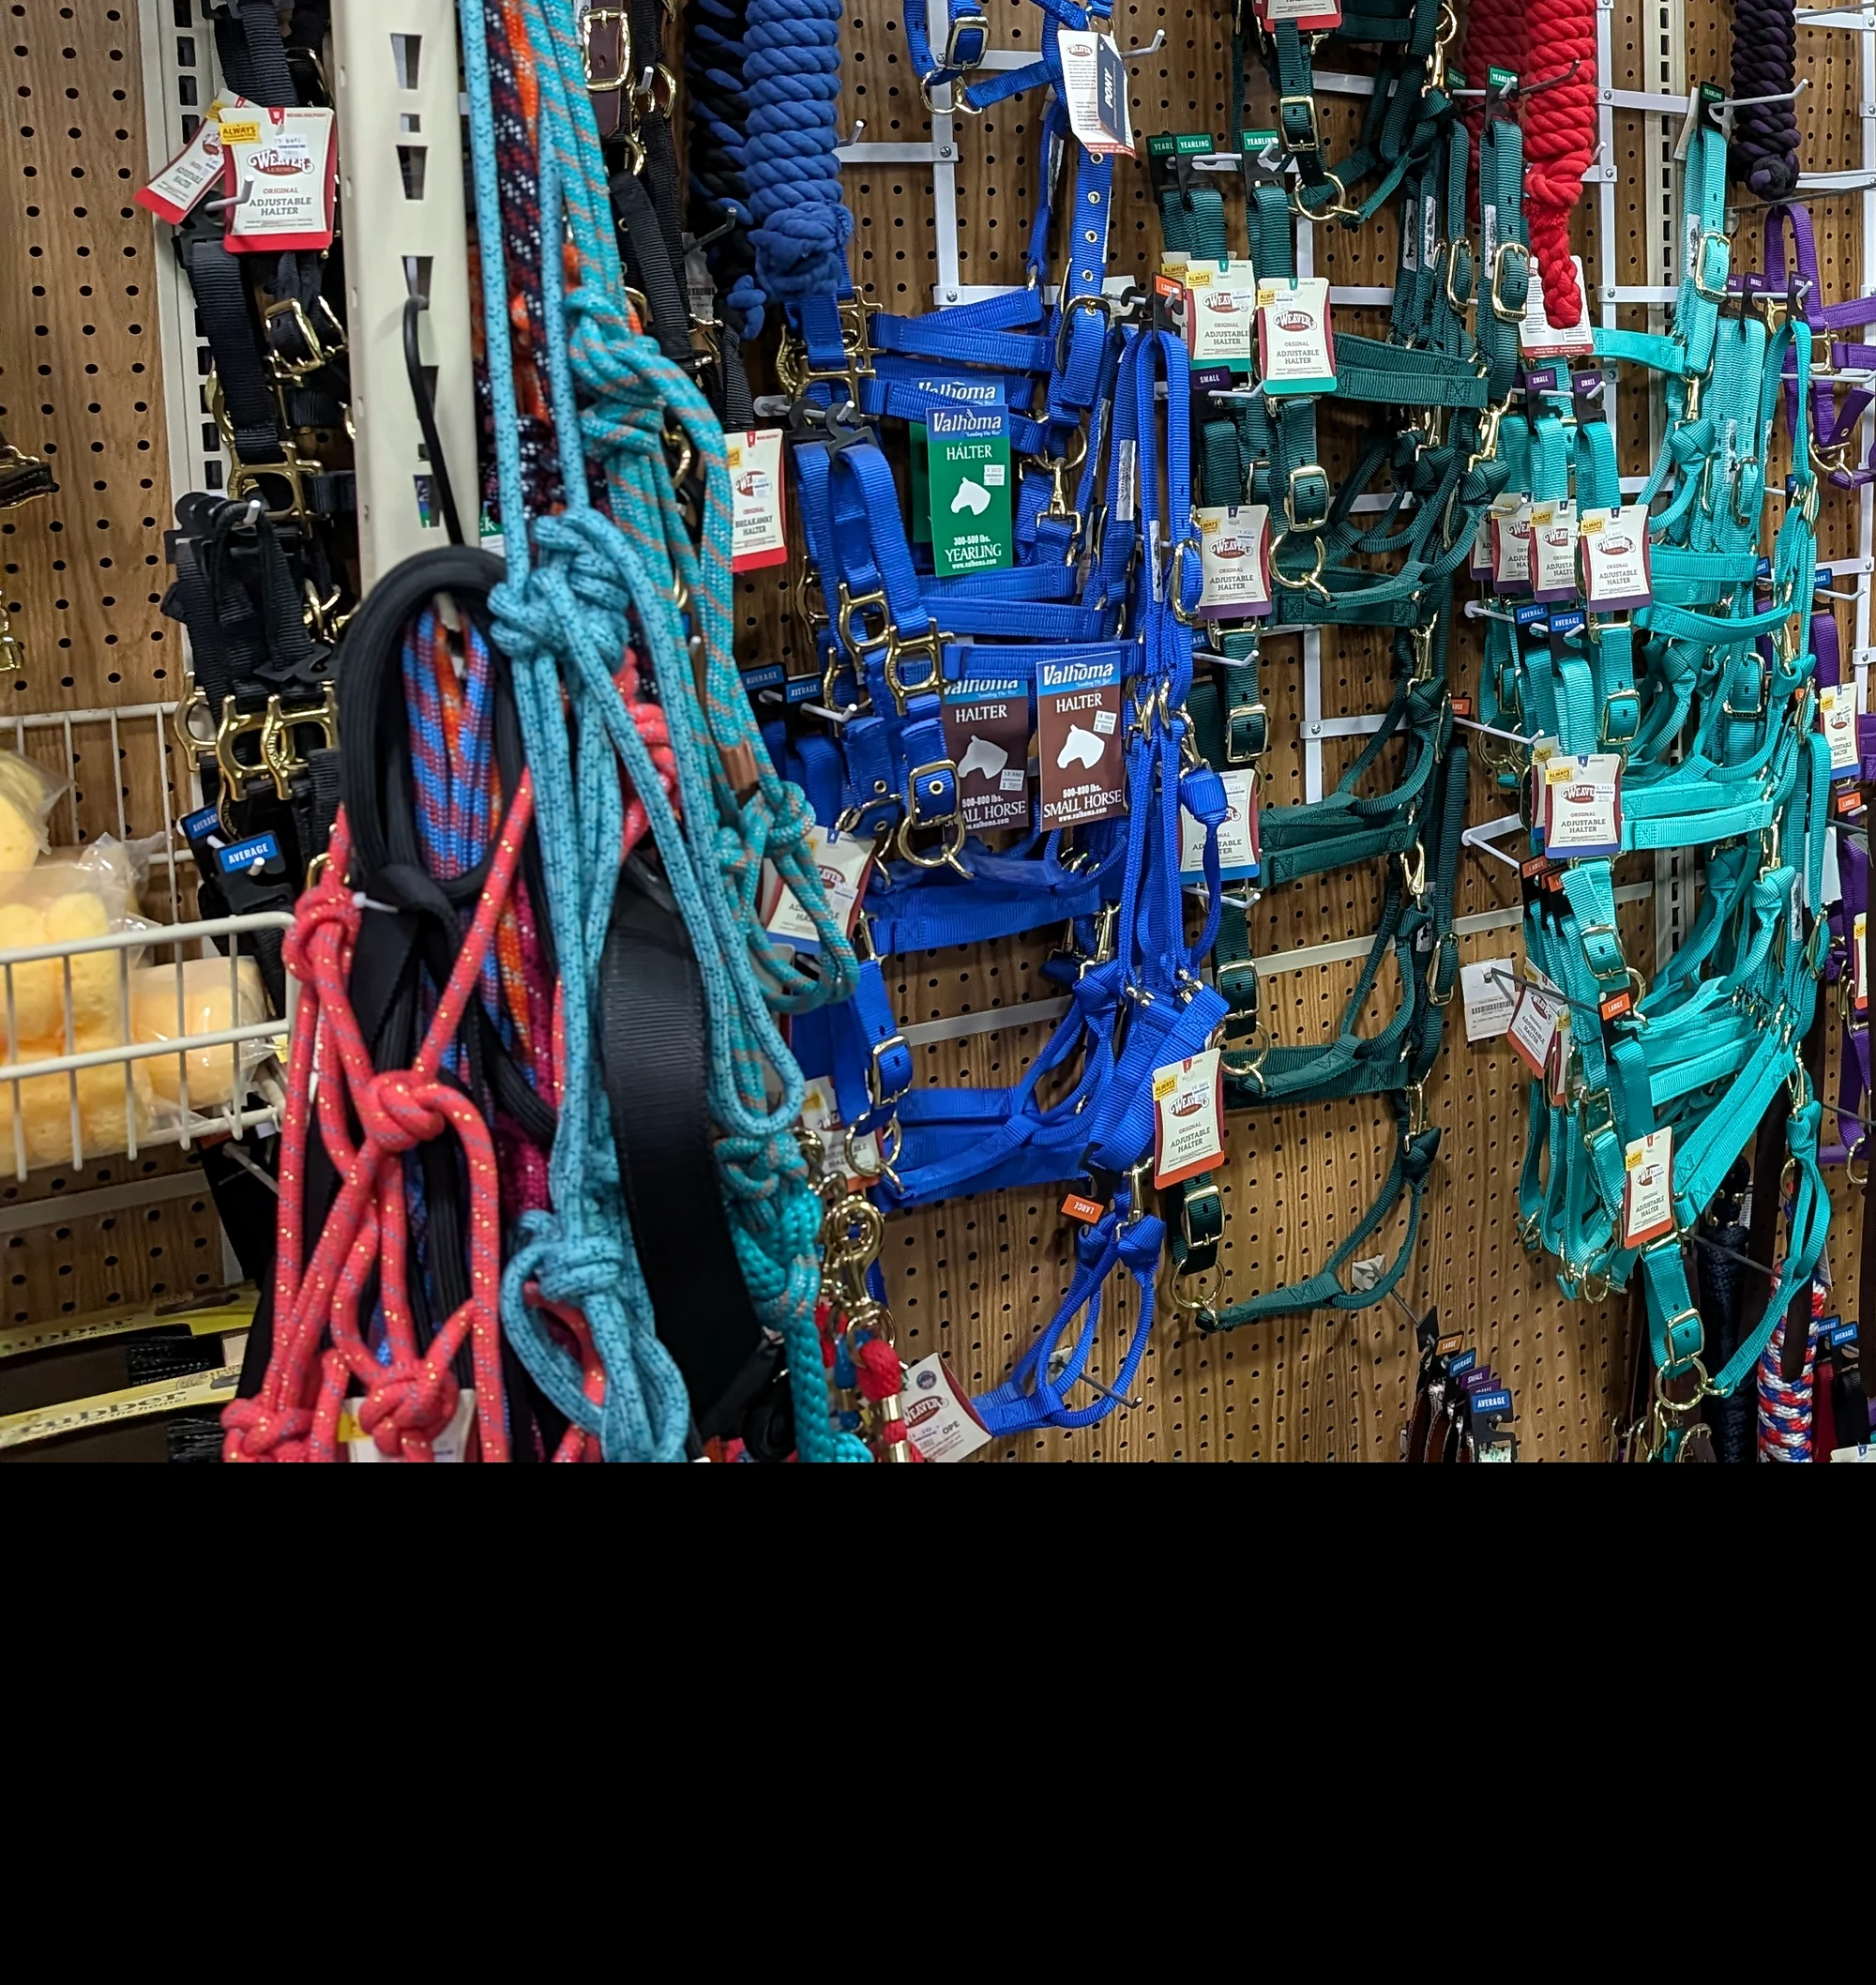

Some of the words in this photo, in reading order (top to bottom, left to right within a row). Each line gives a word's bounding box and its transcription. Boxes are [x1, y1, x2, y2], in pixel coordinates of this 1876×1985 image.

[1104, 68, 1113, 109] PONY
[222, 126, 256, 136] ALWAYS
[1154, 143, 1174, 151] YEARL
[1180, 139, 1210, 149] YEARLING
[1247, 137, 1273, 147] YEARLI
[250, 197, 311, 207] ADJUSTABLE
[261, 207, 298, 216] HALTER
[1188, 274, 1211, 283] ALWAYS
[1273, 310, 1318, 330] WEAVER
[1204, 330, 1249, 339] ADJUSTABLE
[1213, 338, 1242, 346] HALTER
[1199, 374, 1220, 385] SMALL
[1533, 375, 1549, 385] SMALL
[933, 413, 1002, 432] Valhoma
[735, 515, 773, 528] BREAKAWAY
[1532, 513, 1551, 523] ALWAYS
[743, 525, 766, 536] HALTER
[1582, 521, 1603, 530] ALWAYS
[954, 535, 978, 546] 300-500
[945, 543, 1002, 563] YEARLING
[1546, 563, 1575, 571] ADJUSTA
[1210, 575, 1253, 584] ADJUSTABLE
[1599, 569, 1638, 579] ADJUSTABLE
[1521, 608, 1544, 619] AVERAGE
[1555, 617, 1580, 628] AVERAGE
[746, 671, 778, 685] AVERAGE
[1043, 662, 1114, 687] Valhoma
[791, 684, 818, 697] AVERAGE
[1056, 692, 1102, 713] HALTER
[956, 705, 1007, 722] HALTER
[1549, 770, 1570, 779] ALWAYS
[1063, 785, 1090, 798] 500-800
[1561, 784, 1595, 799] WEAVE
[962, 796, 990, 808] 500-800
[1043, 798, 1080, 818] SMALL
[1083, 789, 1122, 809] HORSE
[1842, 798, 1855, 807] LARGE
[985, 800, 1026, 819] HORSE
[1058, 807, 1108, 823] www.valhoma.com
[192, 813, 218, 832] AVERAG
[1561, 819, 1606, 827] ADJUSTABLE
[1192, 839, 1242, 851] ADTABLE
[228, 842, 268, 864] AVERAGE
[1608, 1000, 1624, 1013] LARGE
[1521, 1016, 1545, 1044] ADJUSTABLE
[1523, 1025, 1539, 1045] HALTER
[1156, 1080, 1175, 1092] ALWAYS
[1179, 1122, 1201, 1133] ORIGINAL
[1171, 1127, 1210, 1148] ADJUSTABLE
[1178, 1139, 1203, 1153] HALTER
[1074, 1202, 1095, 1215] LARGE
[1636, 1195, 1664, 1213] ADJUSTABLE
[1642, 1205, 1659, 1218] HALTER
[1834, 1328, 1853, 1341] AVERAGE
[1442, 1340, 1457, 1350] LARGE
[1453, 1356, 1473, 1372] AVERAGE
[1467, 1372, 1484, 1384] SMALL
[1477, 1396, 1505, 1408] AVERAGE
[22, 1390, 187, 1433] rubber
[902, 1397, 949, 1426] WEAVER
